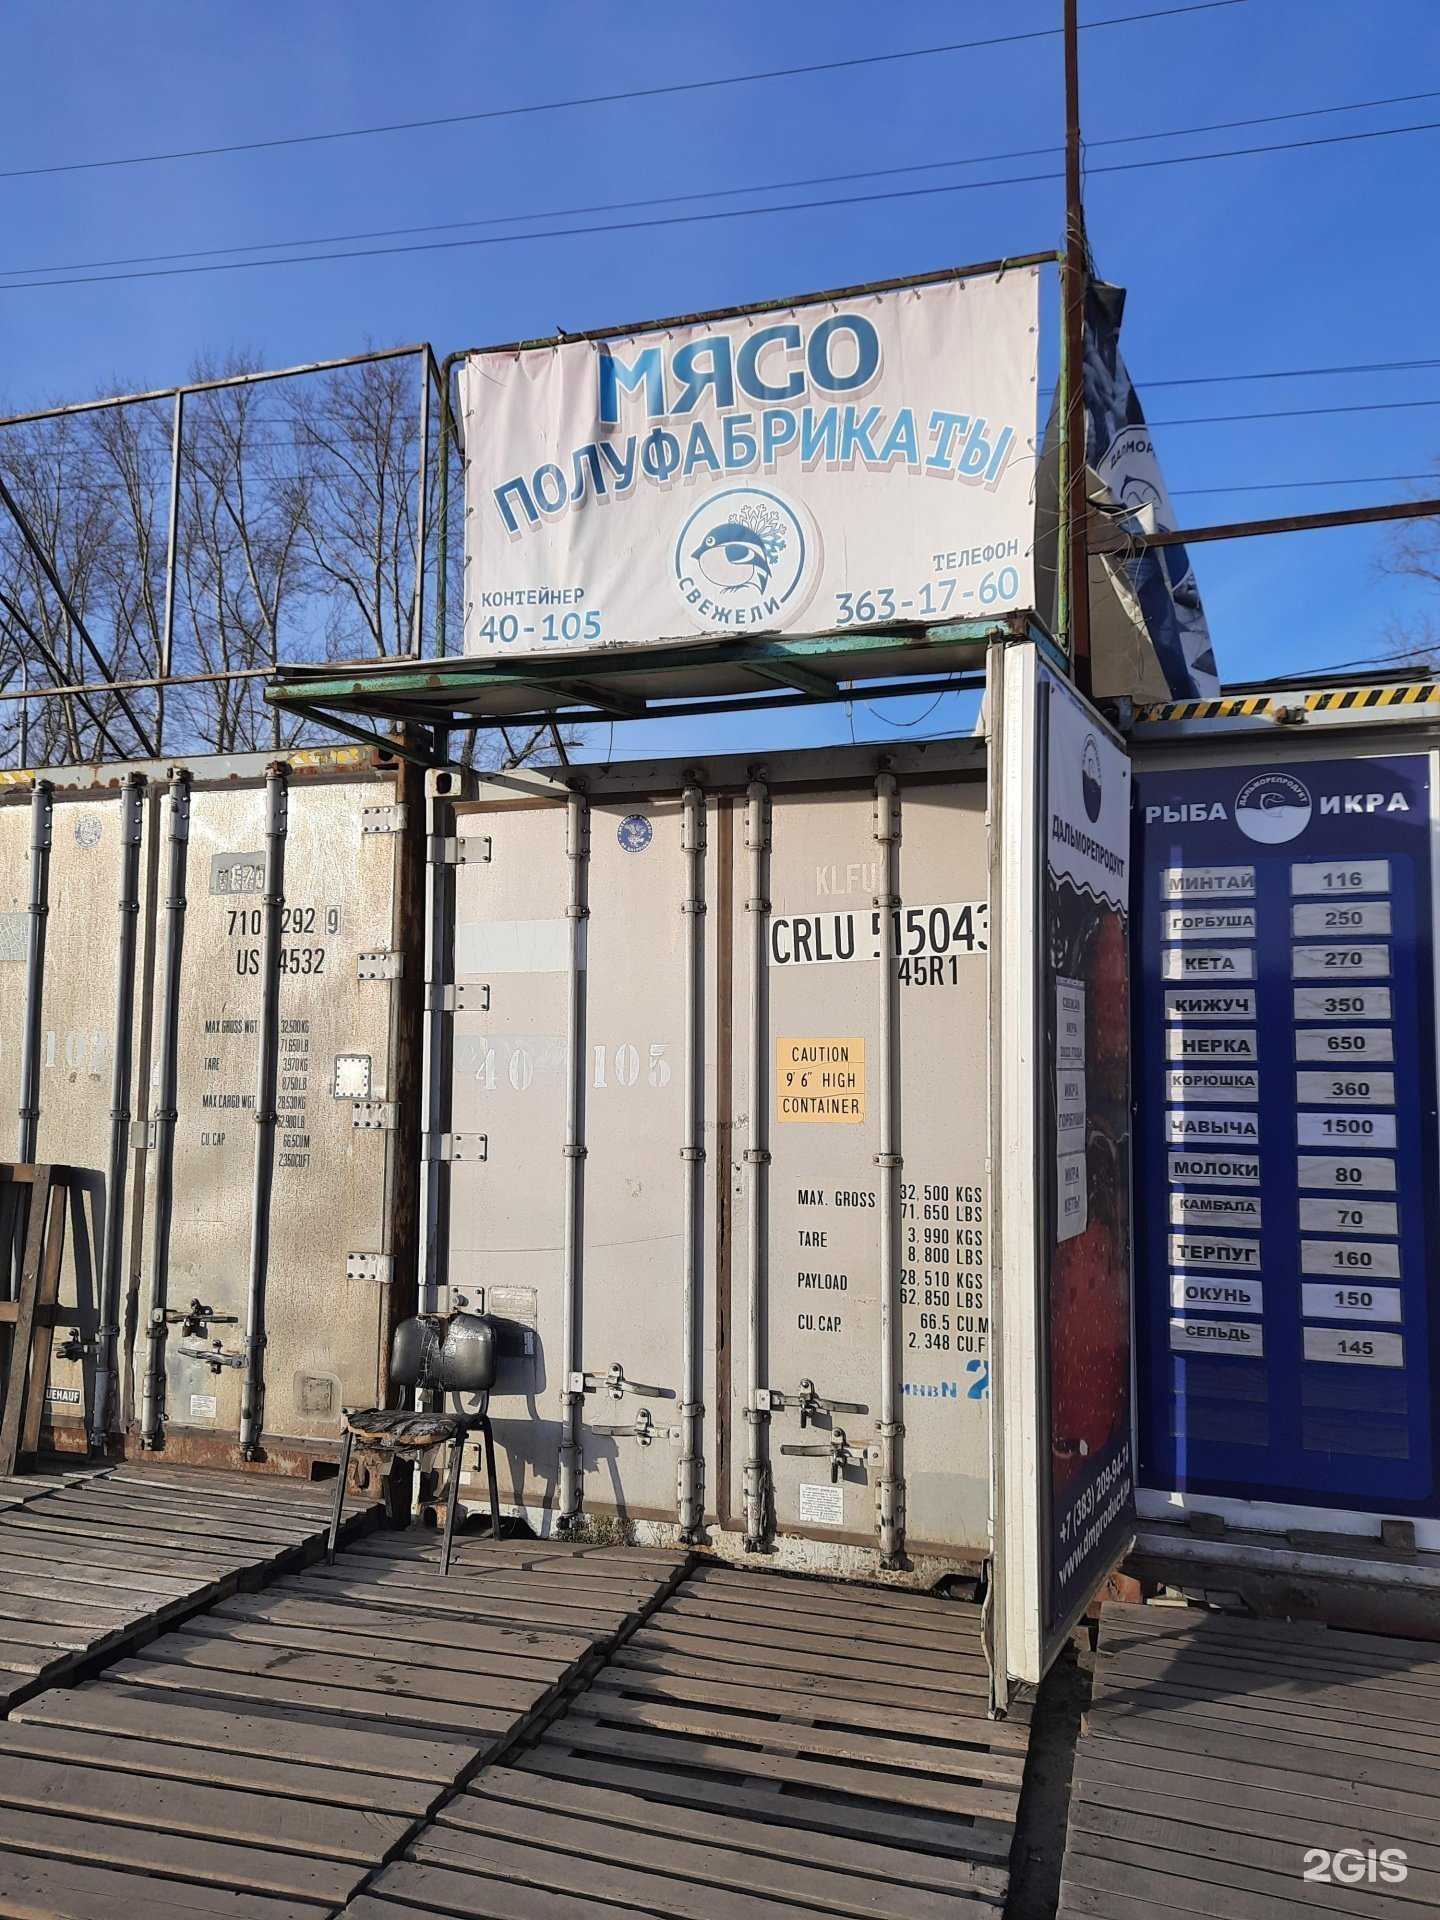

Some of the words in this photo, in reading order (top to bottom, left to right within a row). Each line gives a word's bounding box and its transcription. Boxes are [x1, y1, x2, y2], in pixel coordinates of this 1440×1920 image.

[600, 313, 880, 423] МЯСО
[493, 406, 1016, 535] ПОЛУФАБРИКАТЫ
[933, 539, 1019, 571] ТЕЛЕФОН
[481, 587, 585, 609] КОНТЕЙНЕР
[679, 577, 780, 624] СВЕЖЕЛИ
[836, 566, 1019, 624] 363-17-60
[479, 610, 601, 643] 40-105
[1145, 802, 1228, 824] РЫБА
[1319, 791, 1409, 815] ИКРА
[1052, 815, 1125, 878] ДАЛЬМОРЕПРОДУКТ
[1169, 872, 1255, 890] МИНТАЙ
[1323, 872, 1362, 888] 116
[227, 909, 261, 935] 710
[1172, 914, 1253, 929] ГОРБУША
[1325, 911, 1363, 926] 250
[772, 914, 855, 964] CRLU
[236, 948, 260, 975] US
[278, 948, 325, 974] 4532
[897, 954, 959, 986] 45R1
[1185, 957, 1235, 971] КЕТА
[1325, 952, 1362, 966] 270
[1175, 998, 1249, 1012] КИЖУЧ
[1325, 998, 1365, 1012] 350
[205, 1020, 220, 1034] MAX
[791, 1046, 849, 1062] CAUTION
[1182, 1039, 1251, 1053] НЕРКА
[1328, 1036, 1366, 1050] 650
[204, 1057, 220, 1071] TARE
[593, 1042, 673, 1089] 105
[822, 1072, 856, 1088] HIGH
[1172, 1075, 1255, 1087] КОРЮШКА
[1332, 1082, 1370, 1096] 360
[202, 1094, 217, 1109] MAX
[218, 1095, 240, 1109] CARGO
[241, 1095, 256, 1109] WGT
[782, 1098, 859, 1114] CONTAINER
[1171, 1120, 1257, 1135] ЧАВЫЧА
[1323, 1119, 1374, 1134] 1500
[1174, 1161, 1258, 1176] МОЛОКИ
[1335, 1167, 1362, 1182] 80
[835, 1191, 876, 1208] GROSS
[956, 1186, 983, 1204] KGS
[956, 1206, 983, 1223] LBS
[1180, 1199, 1257, 1213] КАМБАЛА
[1338, 1211, 1363, 1225] 70
[797, 1230, 828, 1248] TARE
[956, 1229, 983, 1247] KGS
[956, 1248, 983, 1266] LBS
[1177, 1244, 1257, 1262] ТЕРПУГ
[1334, 1252, 1372, 1266] 160
[797, 1272, 848, 1291] PAYLOAD
[956, 1272, 983, 1290] KGS
[956, 1291, 983, 1309] LBS
[1185, 1286, 1252, 1303] ОКУНЬ
[1335, 1291, 1373, 1306] 150
[920, 1313, 950, 1331] 66.5
[1186, 1325, 1251, 1341] СЕЛЬДЬ
[1337, 1340, 1374, 1355] 145
[1059, 1511, 1072, 1545] +7
[1073, 1484, 1095, 1536] (383)
